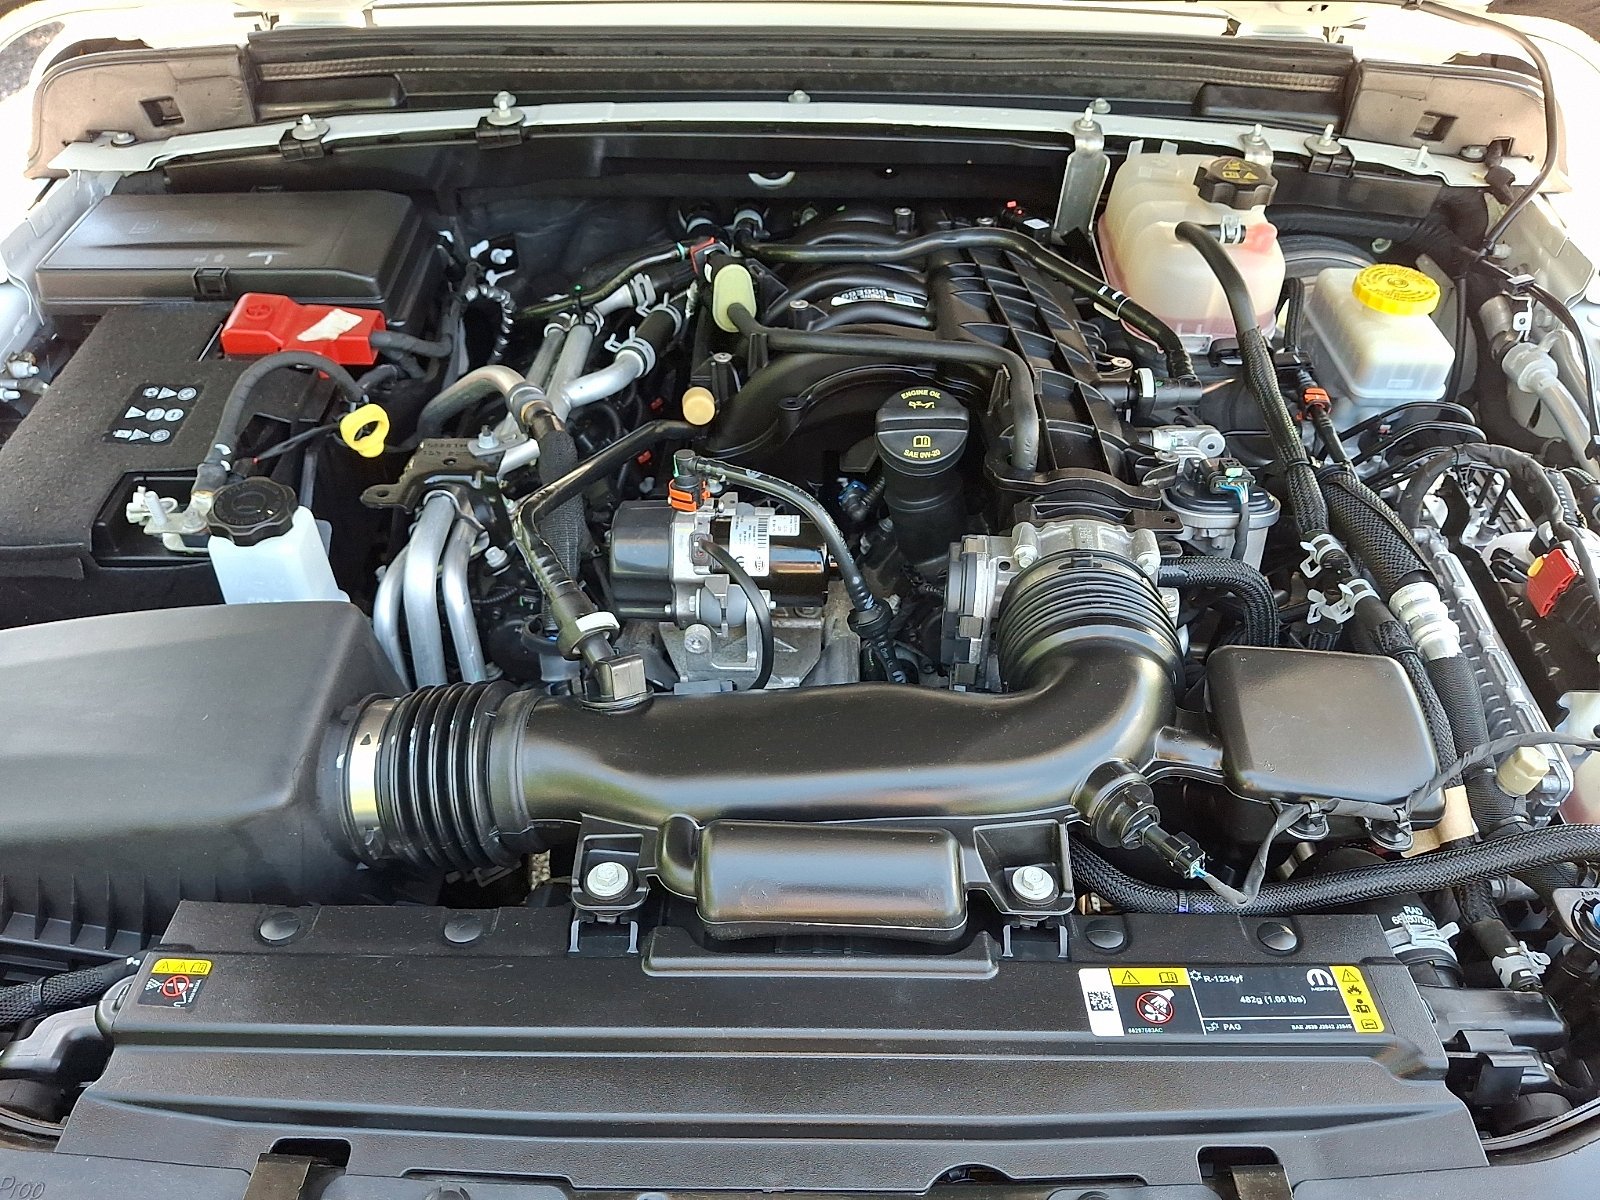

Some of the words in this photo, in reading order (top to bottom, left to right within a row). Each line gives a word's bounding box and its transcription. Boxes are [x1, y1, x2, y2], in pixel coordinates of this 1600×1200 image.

[900, 389, 929, 399] ENGINE
[929, 389, 941, 399] OIL
[903, 448, 919, 458] SAE
[919, 448, 941, 459] 0W-20
[1403, 905, 1424, 916] RAD
[1203, 974, 1244, 984] R-1234yf
[1239, 995, 1264, 1005] 482g
[1288, 994, 1307, 1005] lbs)
[1223, 1023, 1242, 1031] PAG
